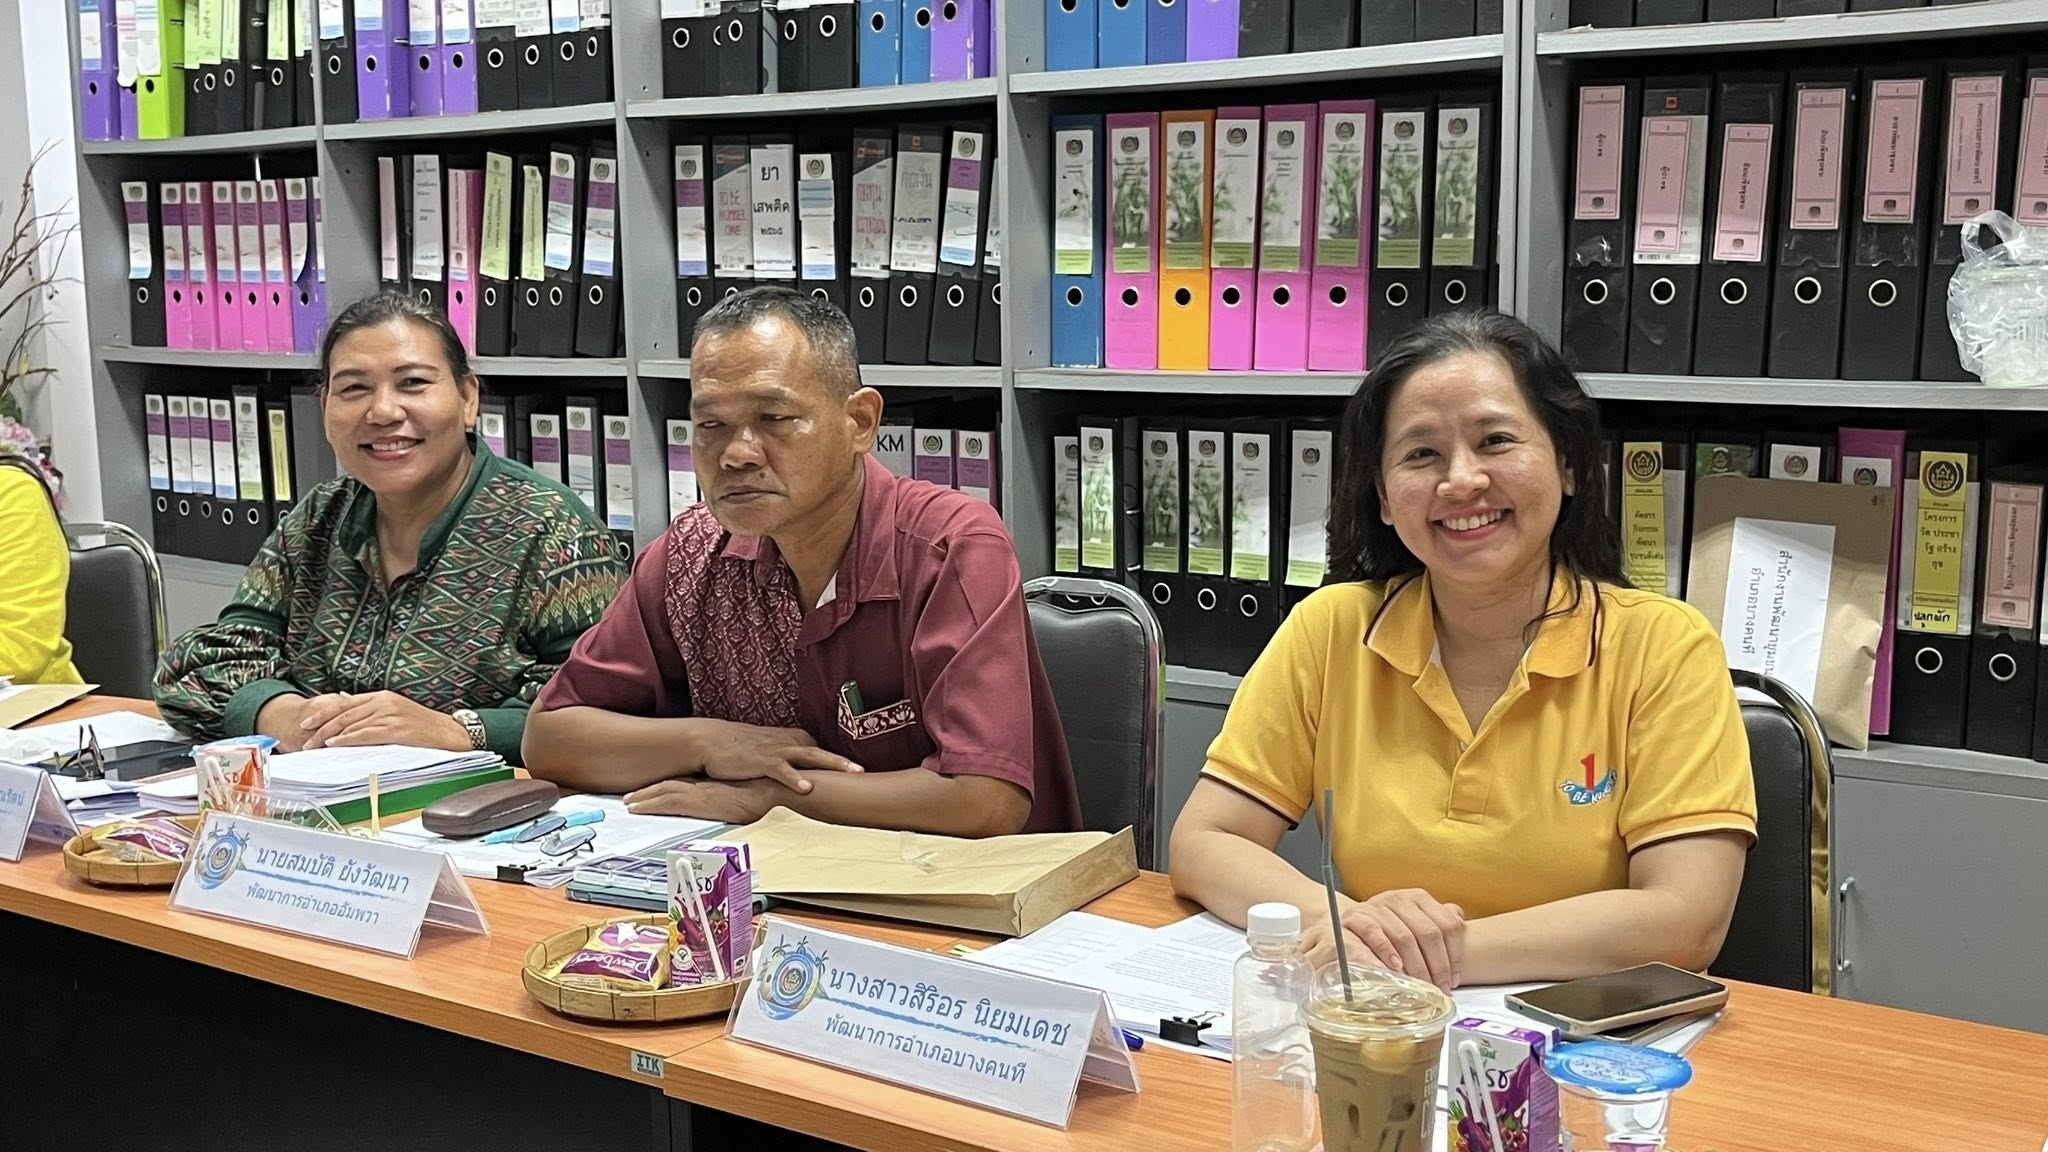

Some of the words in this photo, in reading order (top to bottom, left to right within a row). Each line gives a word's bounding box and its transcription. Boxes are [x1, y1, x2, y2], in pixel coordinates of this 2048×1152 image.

[761, 166, 779, 181] ยา
[753, 199, 790, 213] เสพติด
[877, 434, 904, 452] KM
[1923, 511, 1957, 523] โครงการ
[1742, 567, 1765, 654] อำเภอบางคนที
[256, 847, 336, 878] นายสมบัติ
[338, 859, 410, 894] ยังวัฒนา
[246, 882, 379, 925] พัฒนาการอำเภออัมพวา
[830, 966, 967, 1020] นางสาวสิริอร
[974, 998, 1071, 1047] นิยมเดช
[637, 1053, 660, 1072] ITK
[825, 1013, 1027, 1084] พัฒนาการอำเภอบางคนที
